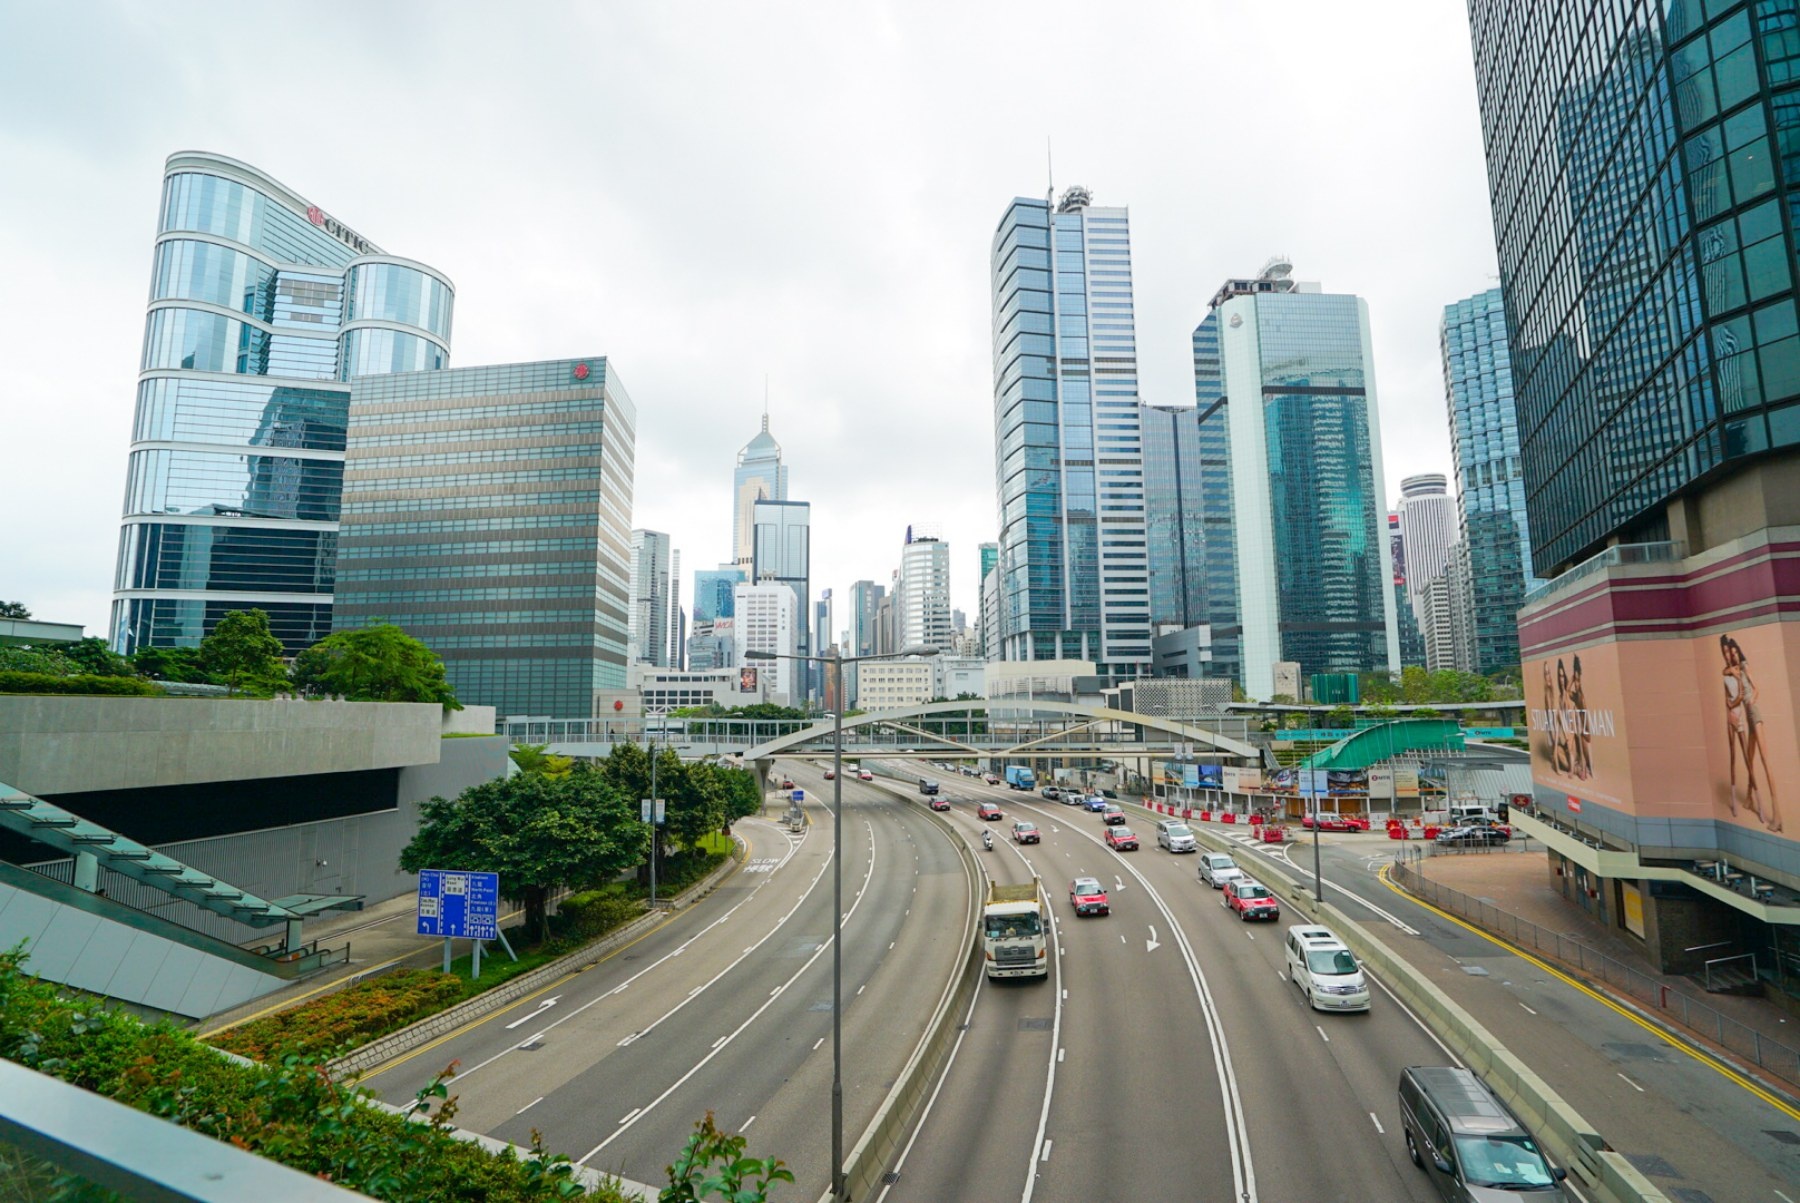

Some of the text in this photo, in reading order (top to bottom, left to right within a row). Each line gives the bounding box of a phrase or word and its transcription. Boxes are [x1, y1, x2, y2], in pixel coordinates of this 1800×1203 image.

[325, 218, 369, 254] CITIC
[1531, 708, 1615, 737] STUART WEITZMAN
